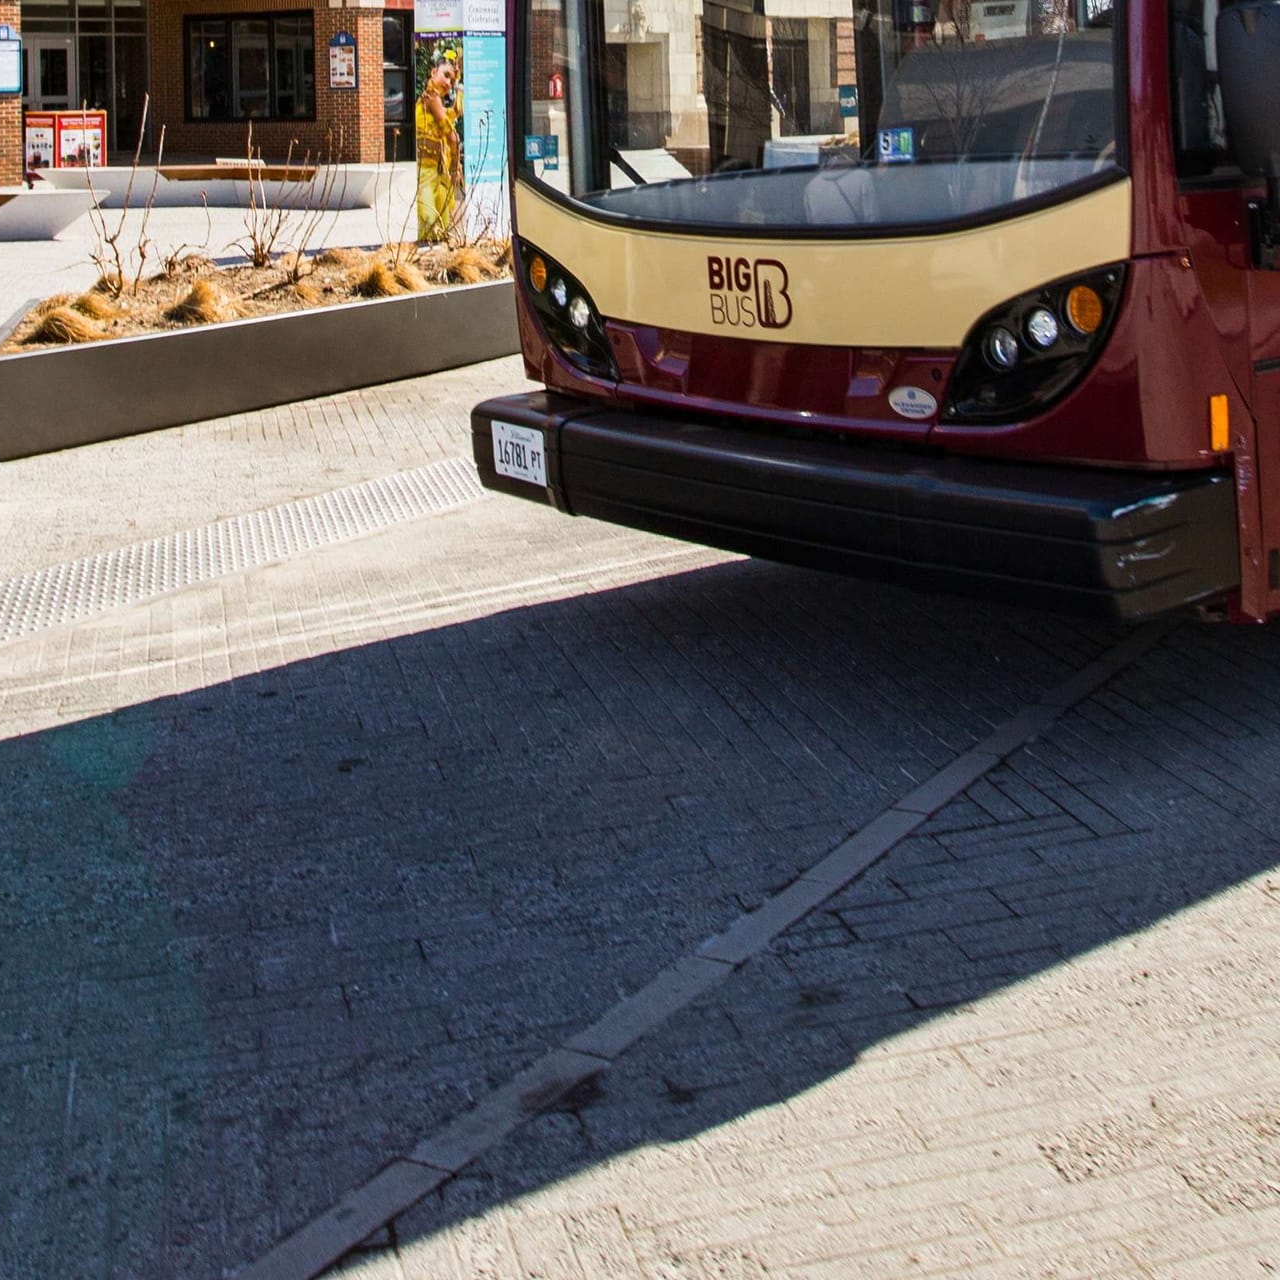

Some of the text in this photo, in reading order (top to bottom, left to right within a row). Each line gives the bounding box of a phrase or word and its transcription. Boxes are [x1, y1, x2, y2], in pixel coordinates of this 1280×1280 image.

[707, 255, 752, 293] BIG
[710, 293, 756, 328] BUS
[498, 438, 542, 471] 16781 PT
